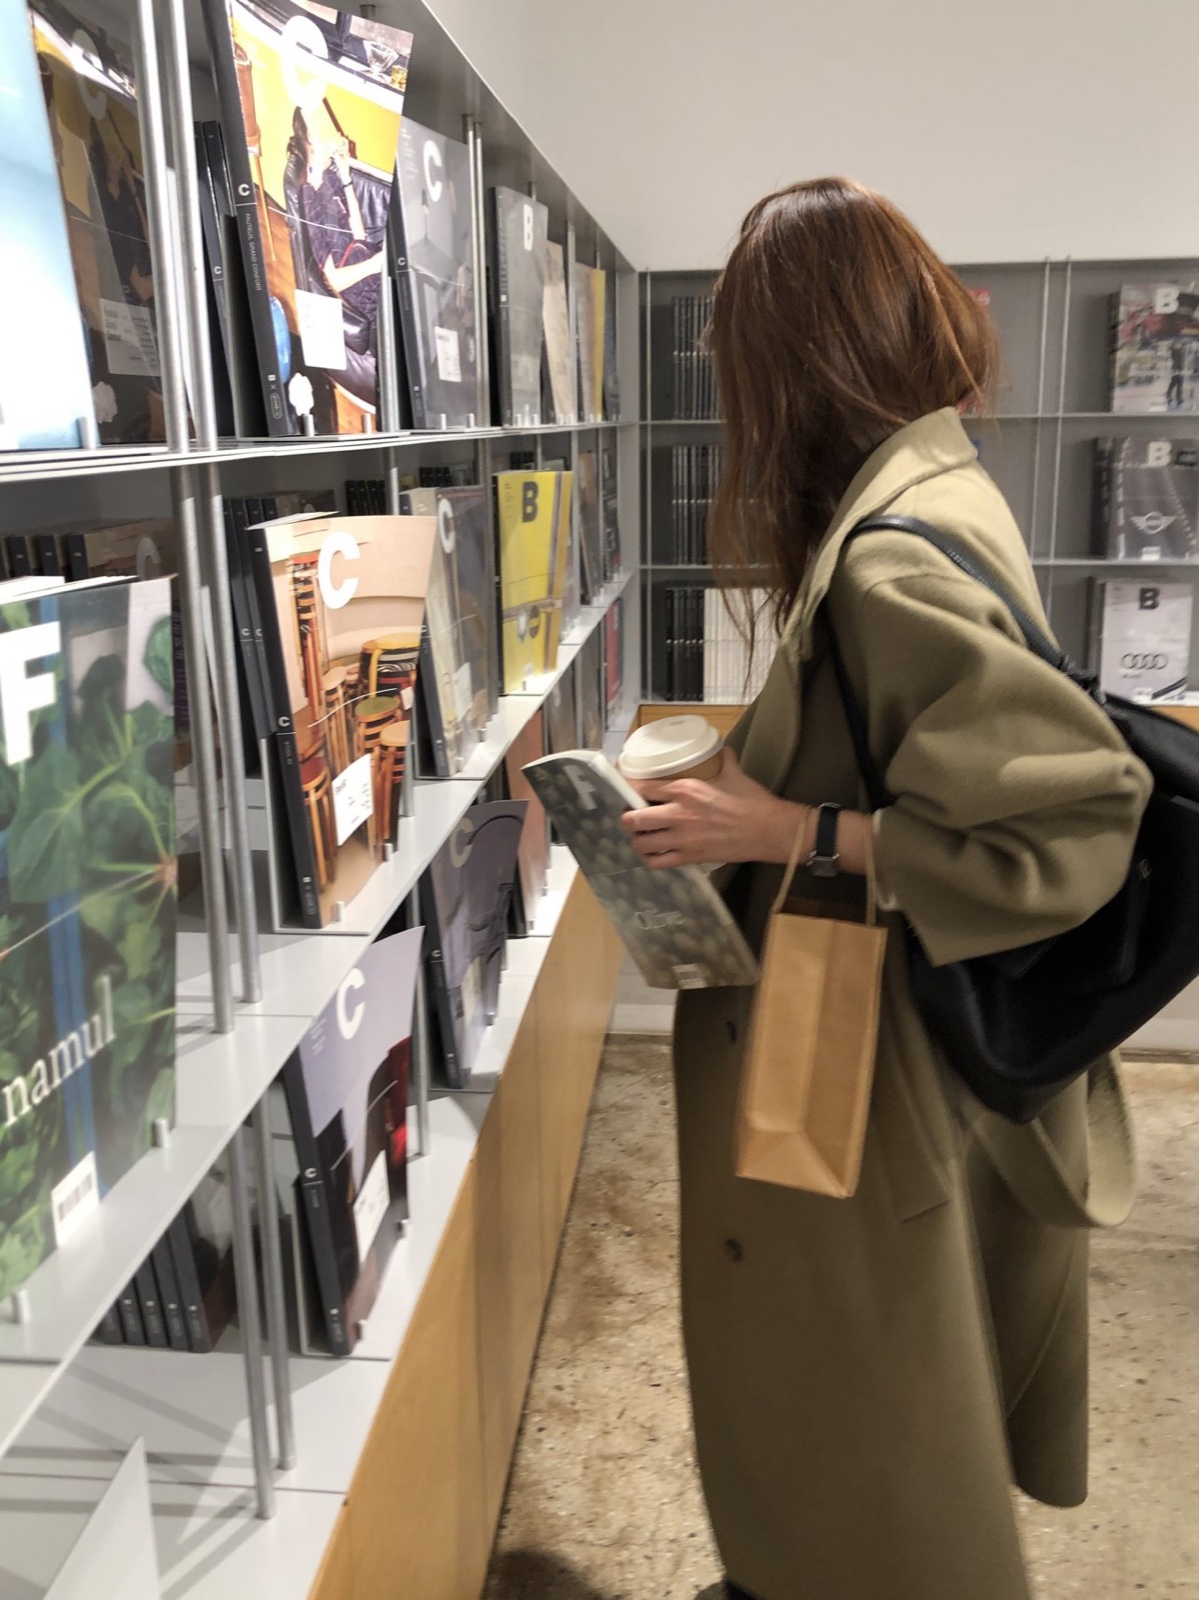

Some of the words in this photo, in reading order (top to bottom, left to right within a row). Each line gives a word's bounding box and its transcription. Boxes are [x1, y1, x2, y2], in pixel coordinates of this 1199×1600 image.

[238, 183, 251, 197] C
[424, 139, 443, 202] C
[523, 203, 534, 252] B
[213, 265, 222, 275] C
[397, 256, 406, 267] C
[1154, 286, 1180, 315] B
[1147, 440, 1172, 469] B
[522, 481, 539, 523] B
[438, 498, 456, 553] C
[317, 531, 361, 609] C
[1139, 587, 1160, 610] B
[241, 627, 250, 636] C
[0, 621, 61, 767] F
[278, 716, 291, 727] C
[563, 765, 598, 811] F
[449, 817, 475, 868] C
[336, 967, 366, 1040] C
[1, 973, 117, 1128] namul
[304, 1167, 318, 1179] C
